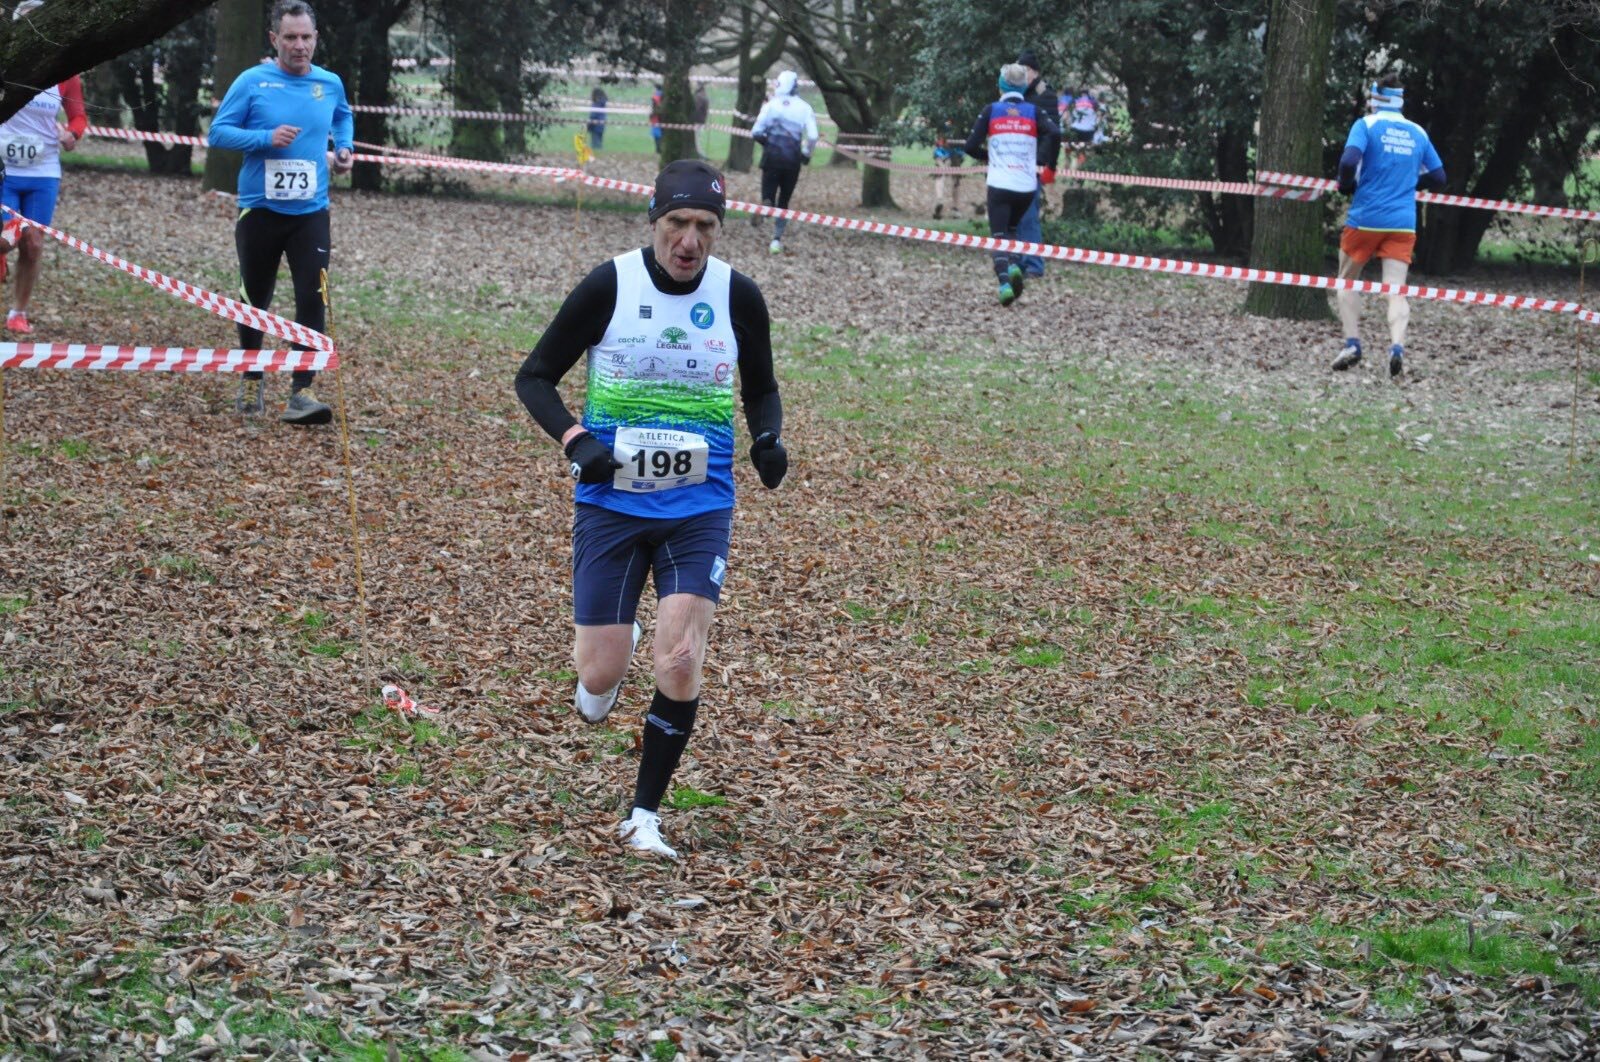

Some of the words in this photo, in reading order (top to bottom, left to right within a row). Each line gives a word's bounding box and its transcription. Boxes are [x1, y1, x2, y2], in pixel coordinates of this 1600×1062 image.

[7, 144, 36, 159] 610
[274, 172, 309, 189] 273
[696, 310, 709, 323] 7
[656, 342, 692, 351] LEGNAMI
[638, 432, 685, 442] ATLETICA
[631, 449, 692, 477] 198
